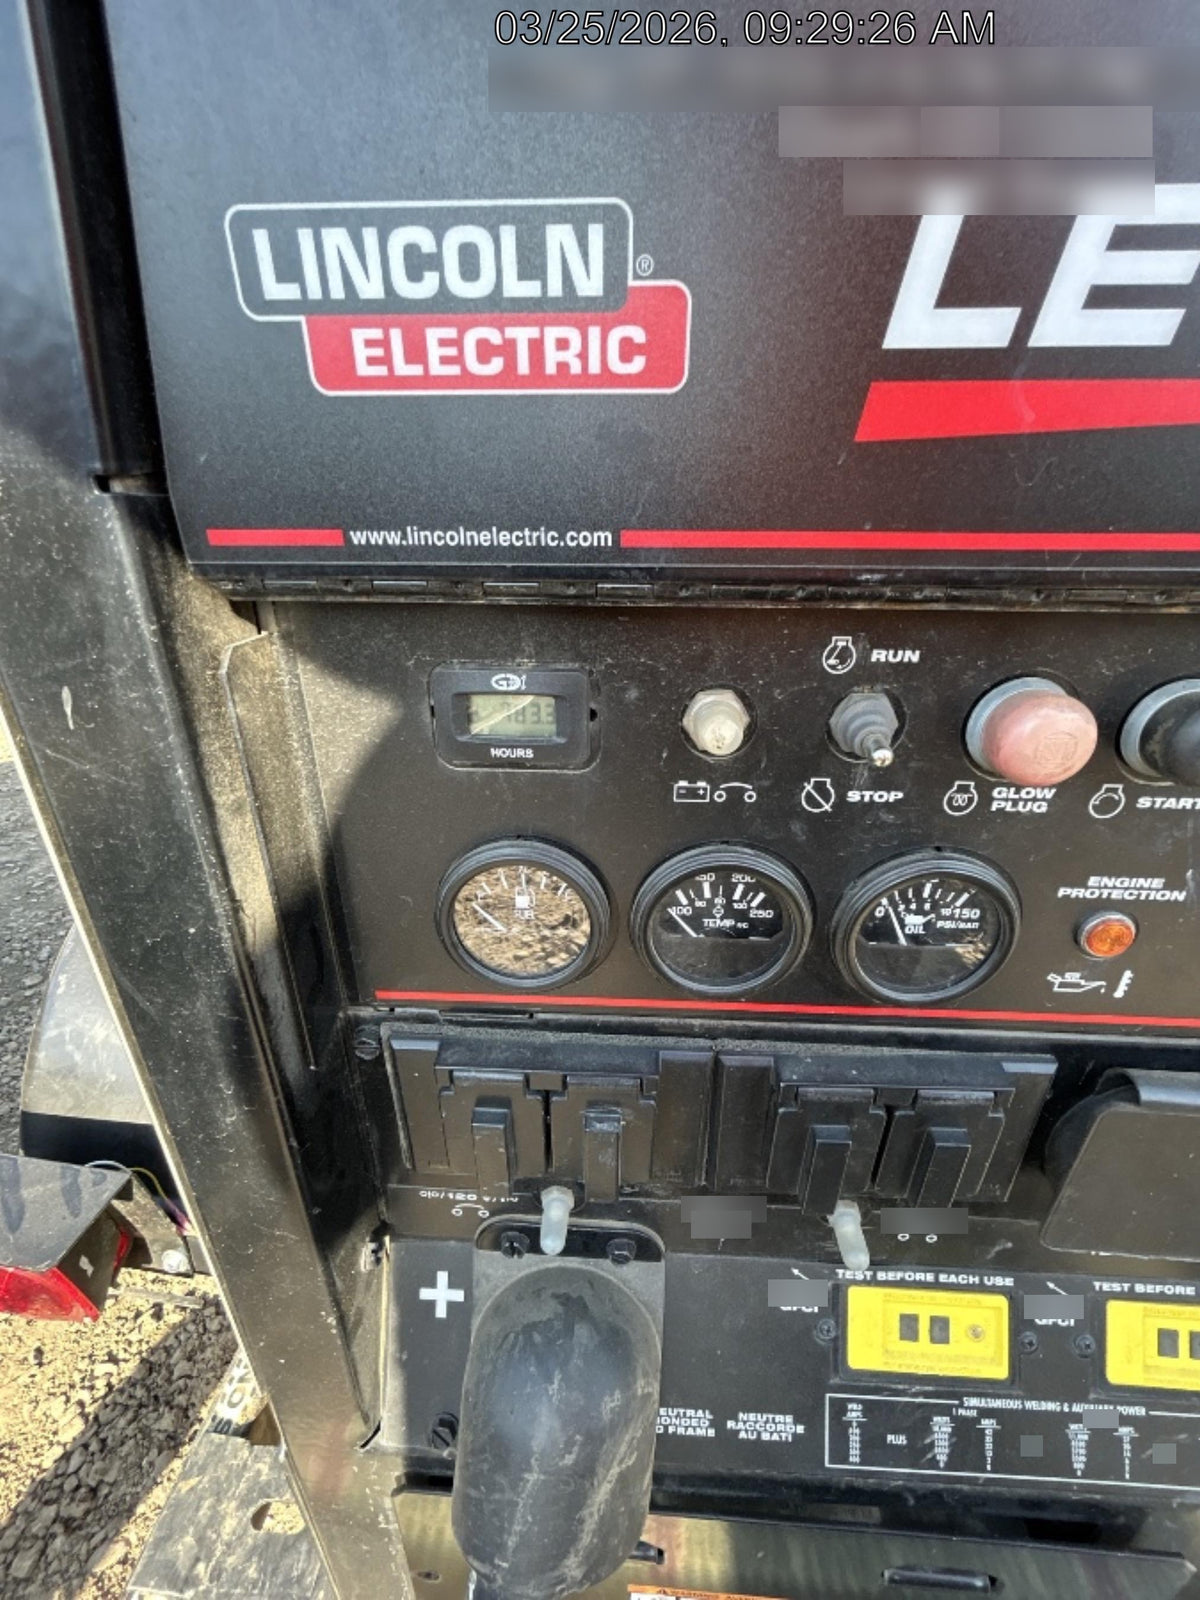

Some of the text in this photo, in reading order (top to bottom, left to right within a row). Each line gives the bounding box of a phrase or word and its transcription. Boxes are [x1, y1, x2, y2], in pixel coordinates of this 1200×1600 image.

[252, 223, 604, 300] LINCOLN
[350, 325, 647, 376] ELECTRIC
[350, 526, 613, 548] www.lincolnelectric.com
[871, 649, 920, 663] RUN
[490, 748, 534, 758] HOURS
[846, 791, 904, 803] STOP
[991, 787, 1057, 799] GLOW
[991, 801, 1049, 814] PLUG
[1136, 797, 1200, 810] START
[1087, 876, 1166, 889] ENGINE
[1057, 887, 1187, 902] PROTECTION
[749, 909, 774, 918] 250
[874, 906, 885, 918] 0
[952, 909, 981, 919] 150
[702, 918, 735, 927] TEMP
[904, 926, 926, 934] OIL
[836, 1268, 1015, 1286] TEST BEFORE EACH USE
[1093, 1281, 1196, 1296] TEST BEFORE
[963, 1396, 1023, 1410] SIMULTANEOUS
[1023, 1400, 1061, 1412] WELDING
[657, 1416, 710, 1428] ONDED
[738, 1411, 794, 1424] NEUTRE
[668, 1425, 716, 1437] FRAME
[727, 1420, 805, 1434] RACCORDE
[738, 1430, 792, 1442] AU BATI
[886, 1433, 908, 1445] PLUS
